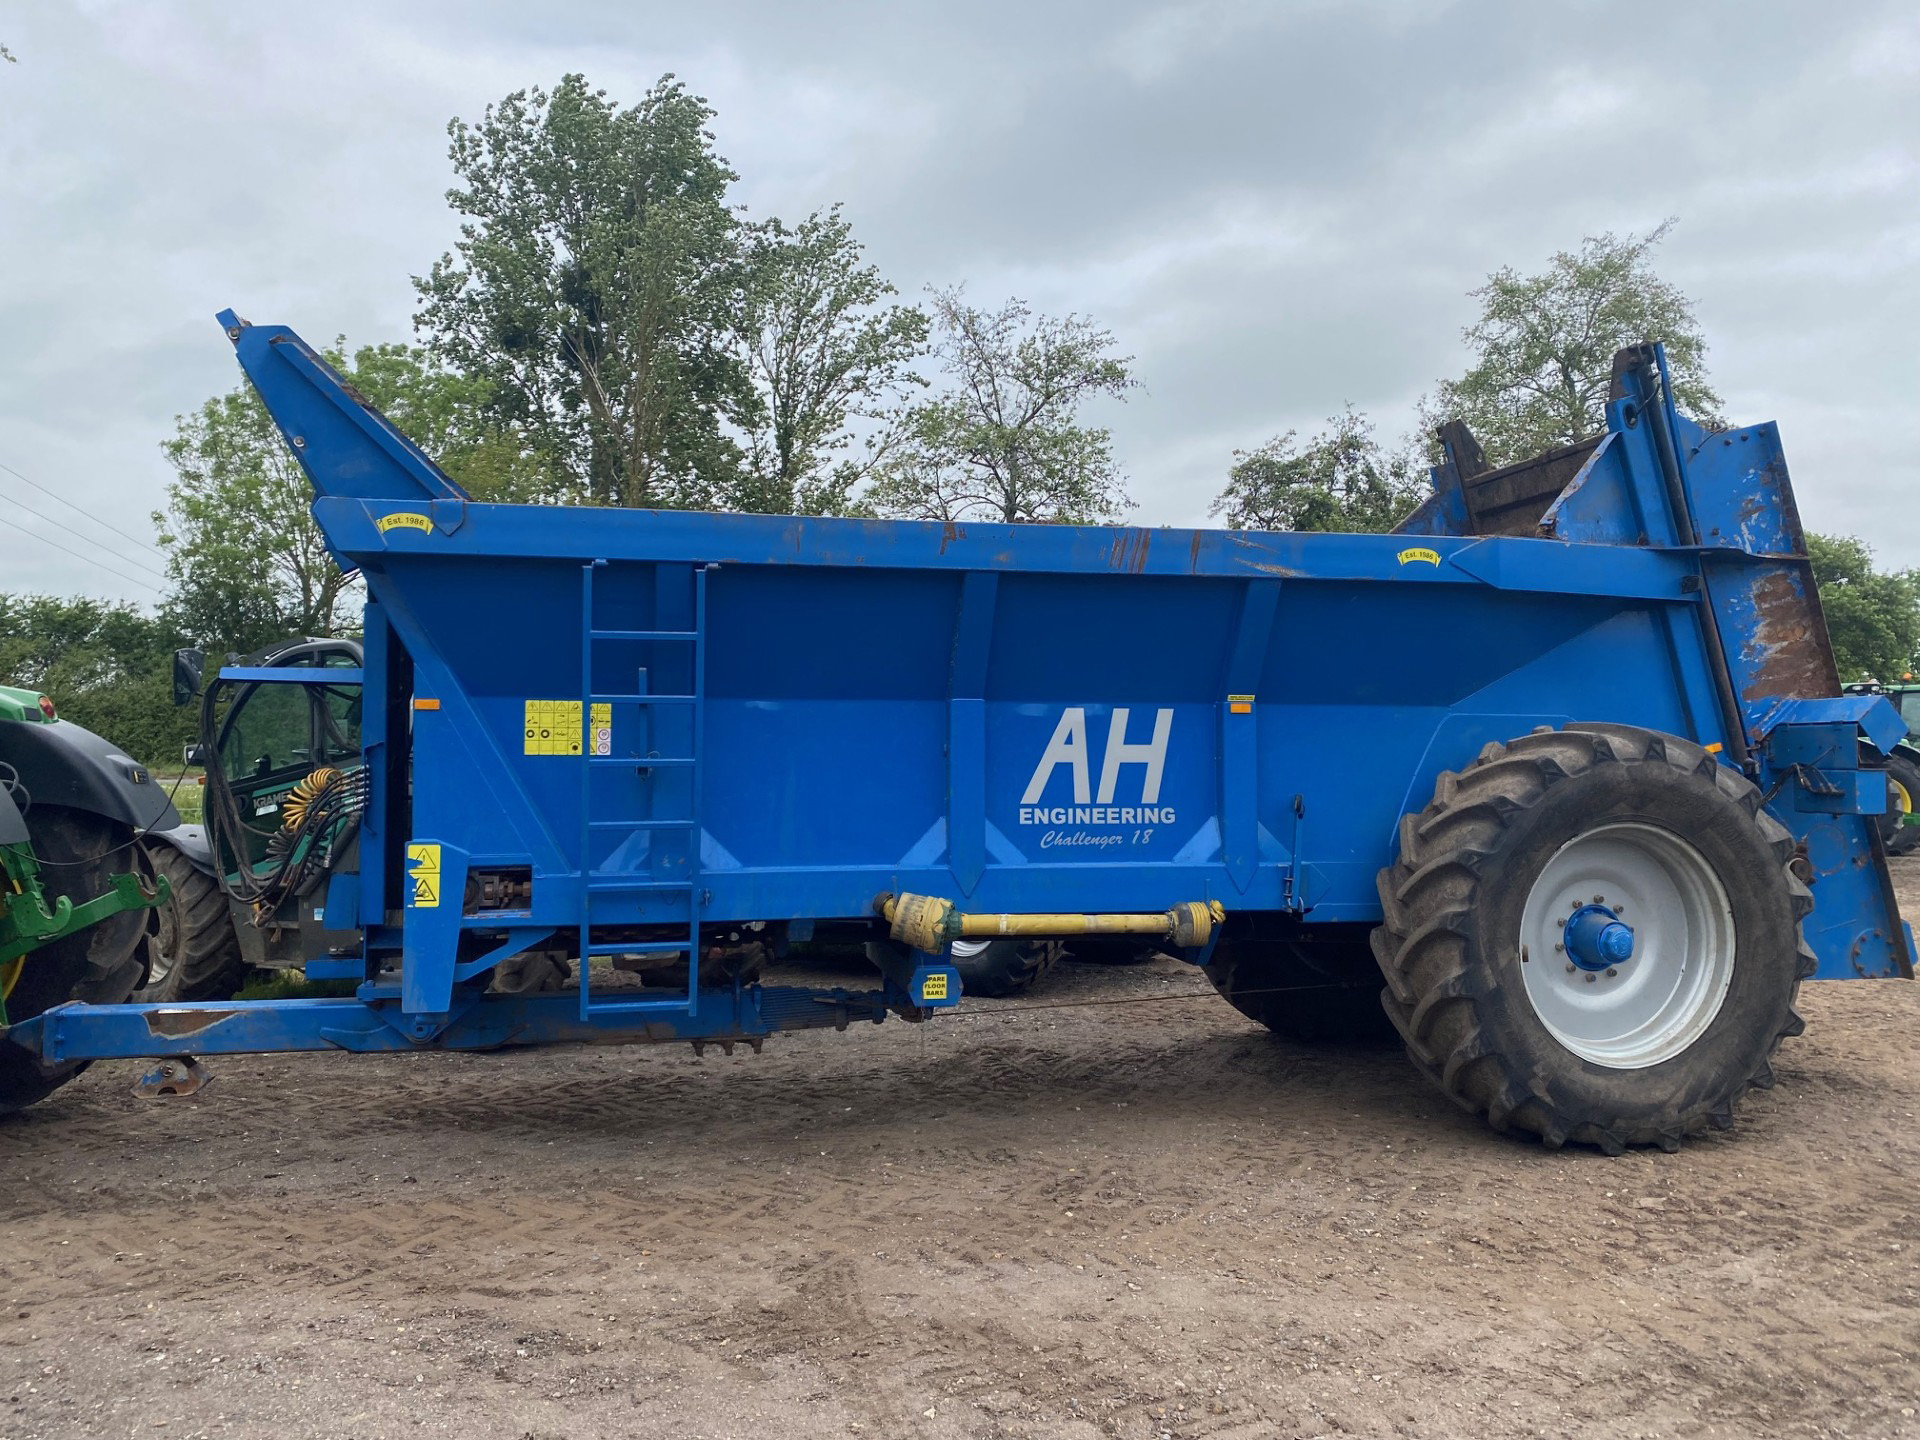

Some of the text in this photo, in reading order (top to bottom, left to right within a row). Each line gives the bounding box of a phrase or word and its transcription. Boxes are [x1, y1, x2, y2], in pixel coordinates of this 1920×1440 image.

[387, 517, 424, 526] Est. 1986
[1020, 707, 1174, 804] AH
[1019, 807, 1176, 825] ENGINEERING
[1040, 828, 1154, 850] Challenger 18
